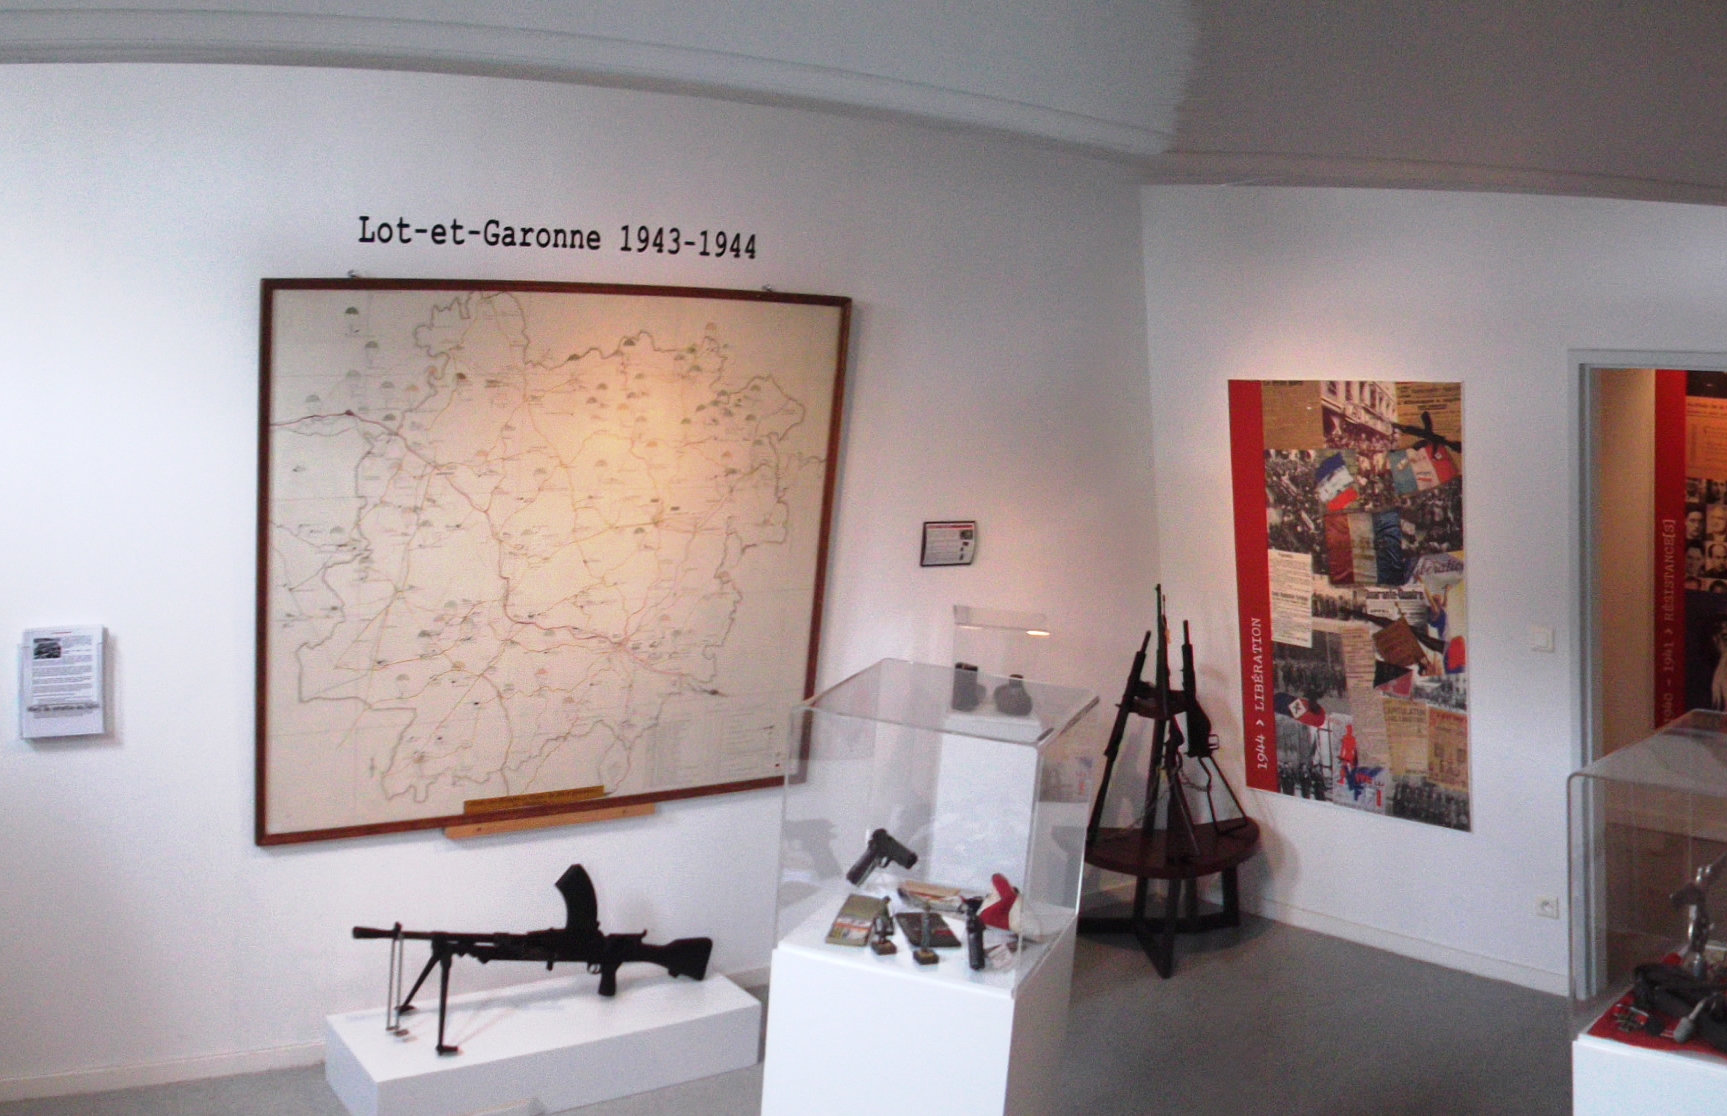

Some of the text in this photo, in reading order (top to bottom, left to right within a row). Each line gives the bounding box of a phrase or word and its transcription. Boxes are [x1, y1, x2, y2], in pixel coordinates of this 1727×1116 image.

[358, 215, 758, 260] Lot-et-Garonne 1943-1944
[1251, 618, 1265, 711] LIBÉRATION
[1255, 734, 1268, 769] 1944
